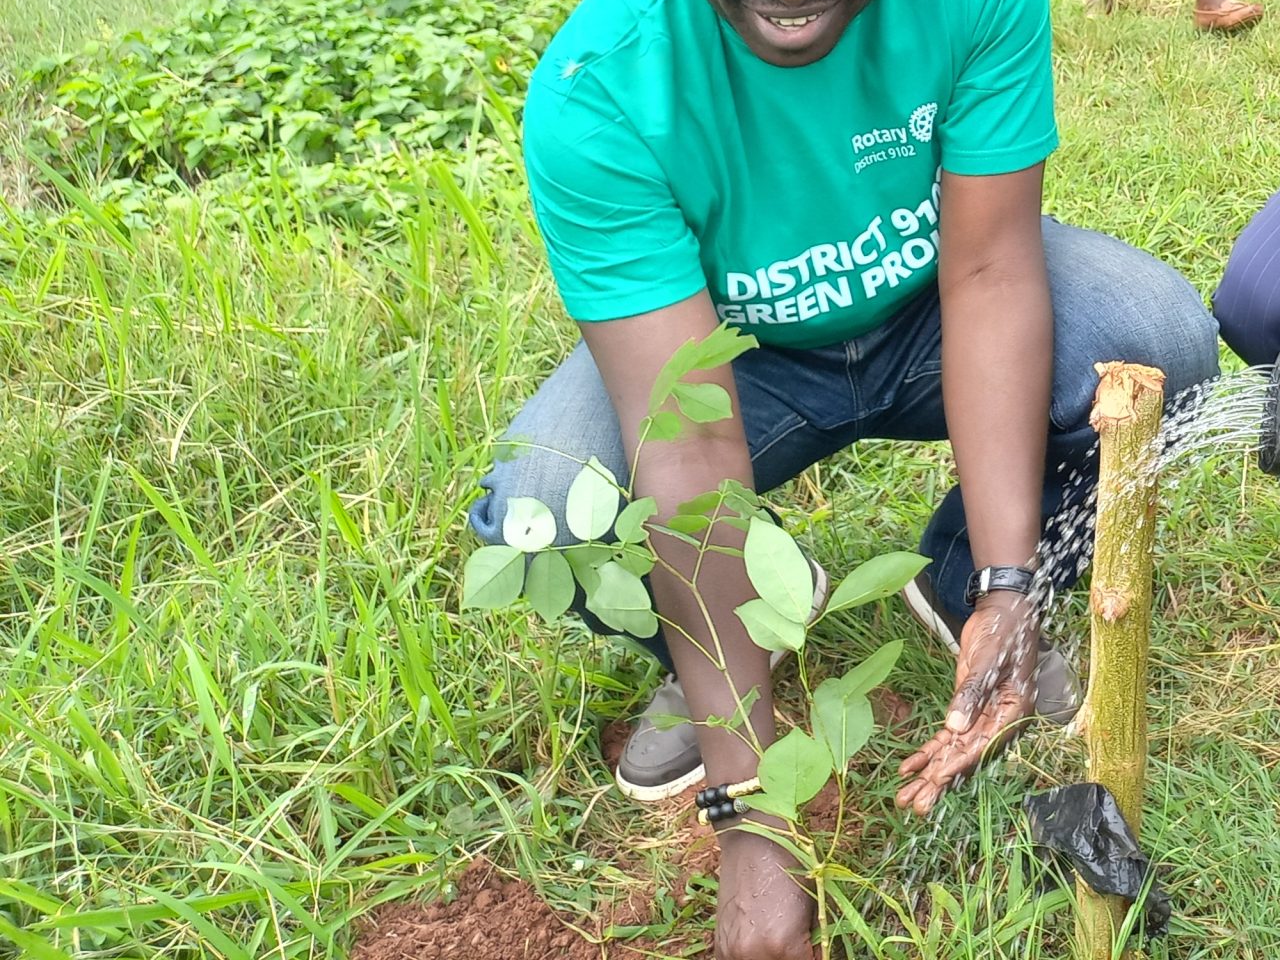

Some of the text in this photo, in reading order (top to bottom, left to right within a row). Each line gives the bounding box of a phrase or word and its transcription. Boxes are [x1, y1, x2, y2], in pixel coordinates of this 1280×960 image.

[851, 127, 908, 153] Rotary
[853, 144, 917, 175] District 9102
[726, 215, 887, 302] DISTRICT
[716, 275, 853, 324] GREEN
